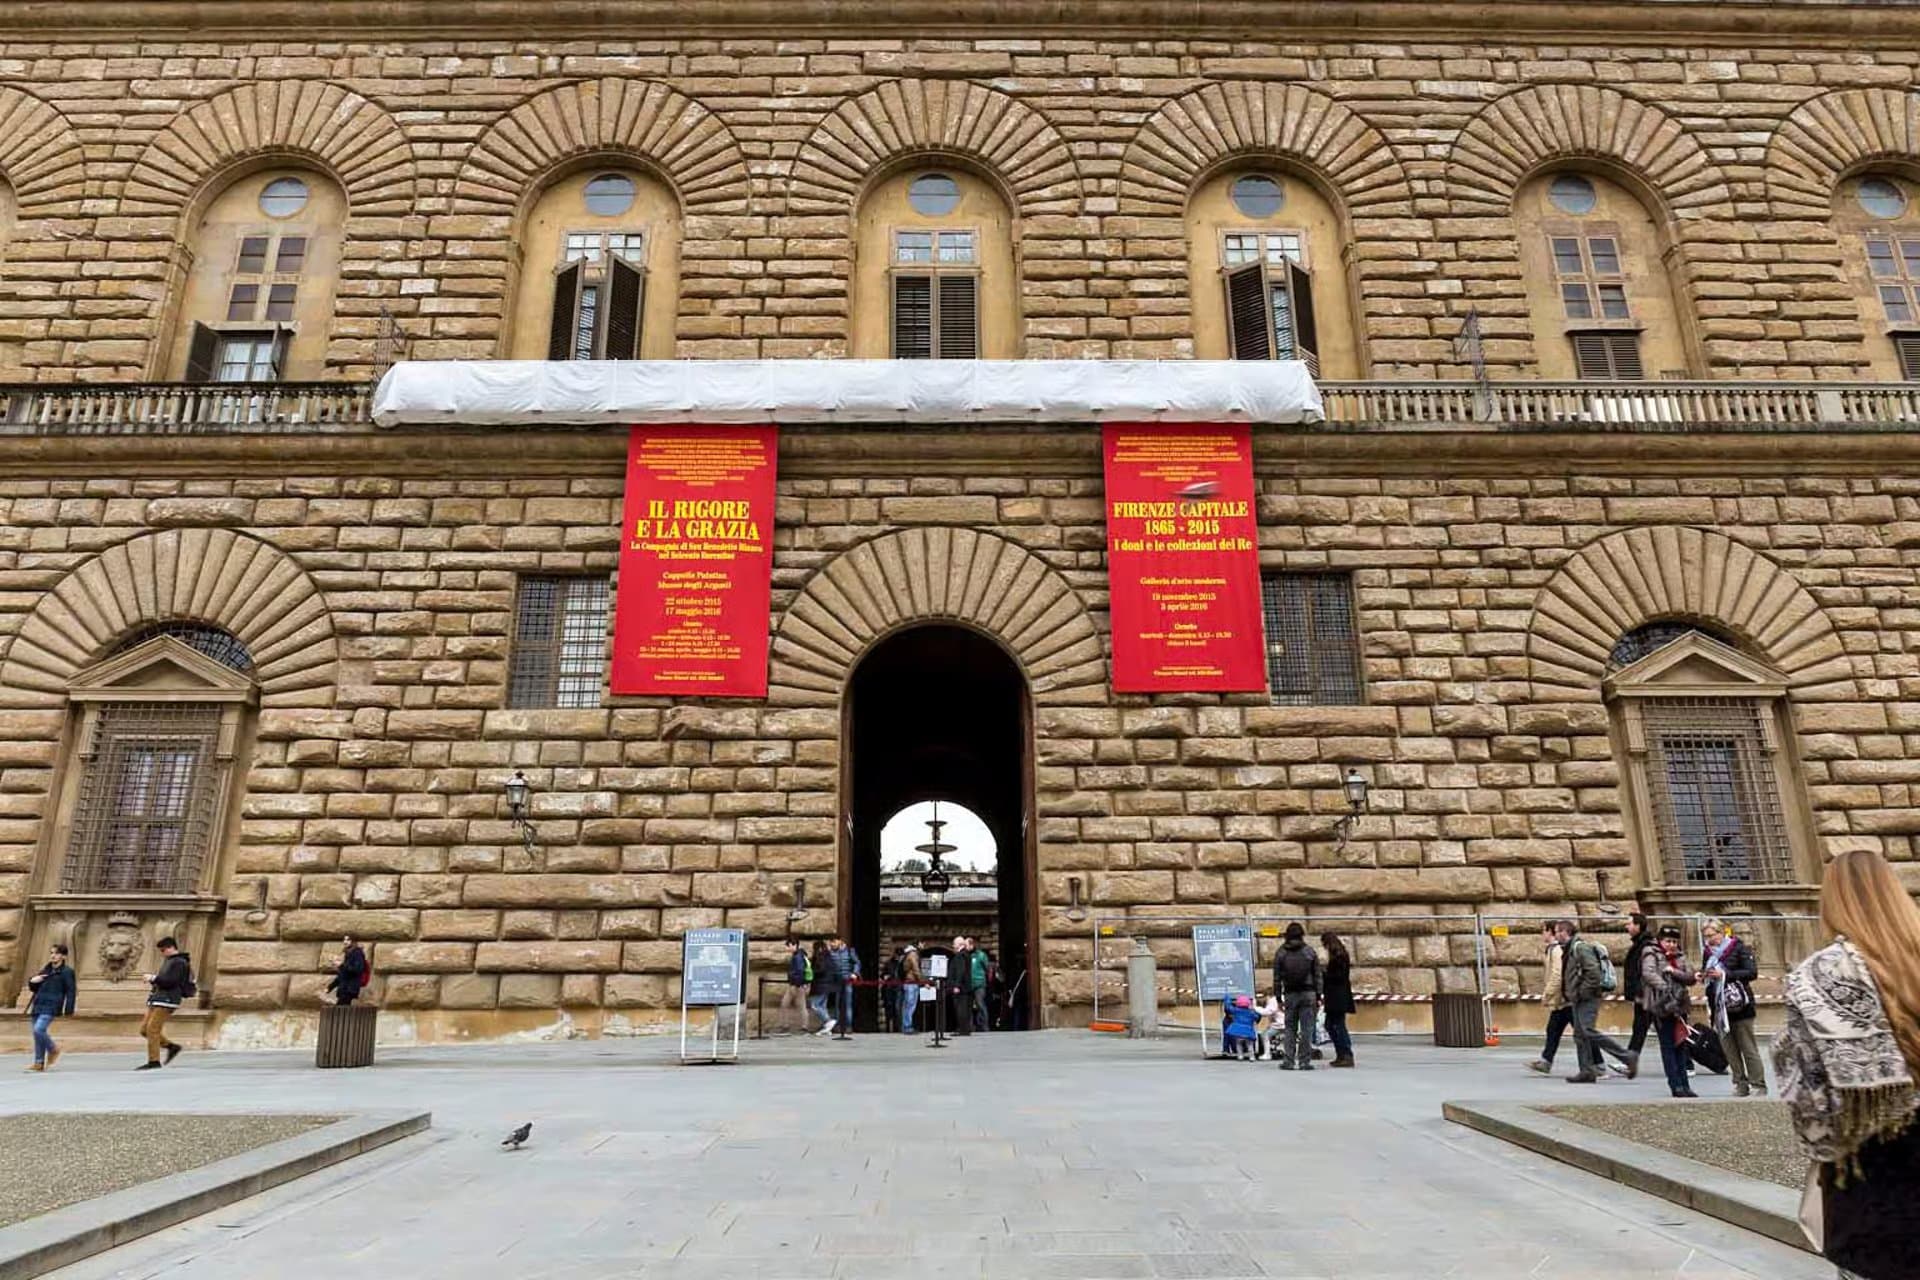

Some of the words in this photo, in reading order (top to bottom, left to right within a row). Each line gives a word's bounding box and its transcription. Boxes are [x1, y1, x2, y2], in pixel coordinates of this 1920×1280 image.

[649, 500, 669, 519] IL
[674, 500, 750, 519] RIGORE
[1113, 502, 1177, 518] FIRENZE
[1180, 500, 1249, 518] CAPITALE
[636, 520, 650, 539] E
[655, 520, 681, 539] LA
[685, 520, 760, 541] GRAZIA
[1145, 520, 1176, 536] 1865
[1187, 520, 1220, 535] 2015
[630, 541, 641, 550] La
[641, 541, 680, 553] Compagnia
[1114, 539, 1119, 551] I
[1121, 539, 1145, 551] doni
[1146, 541, 1154, 551] e
[1155, 539, 1166, 551] le
[1166, 538, 1217, 551] collezioni
[1237, 538, 1253, 551] Re
